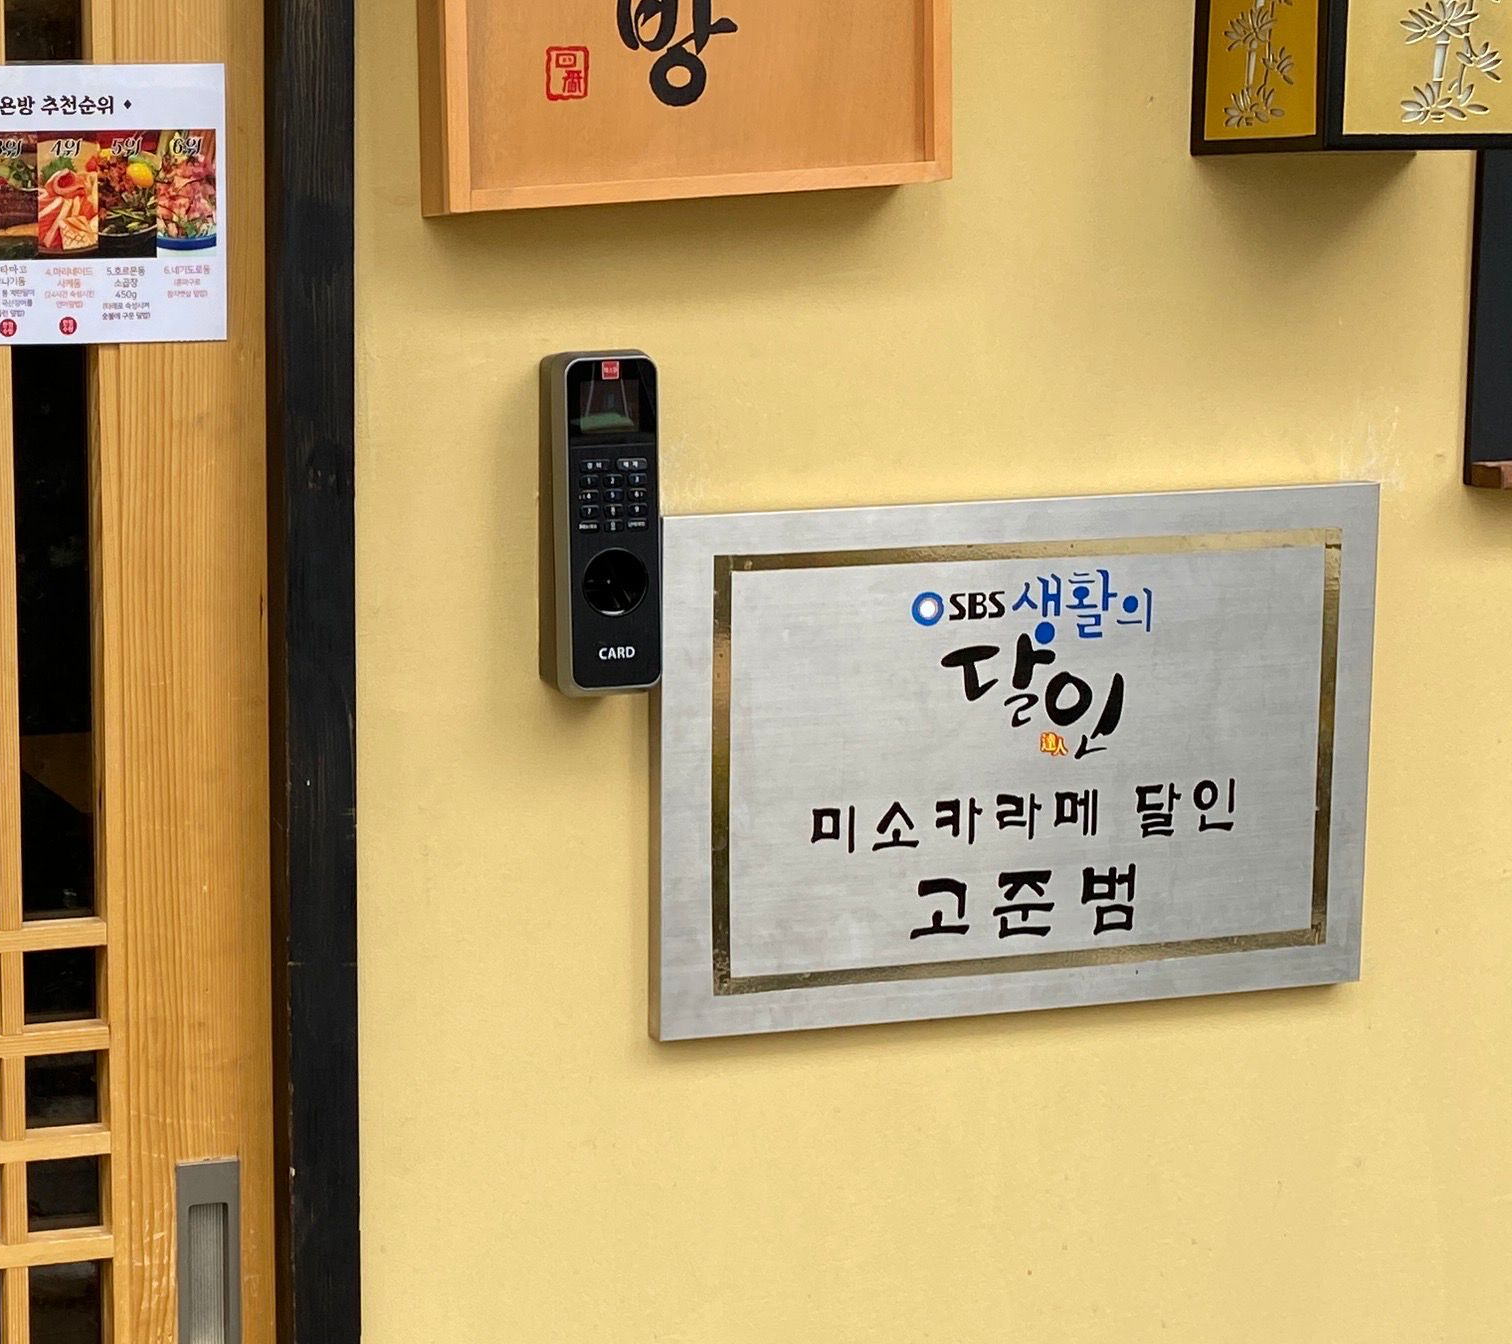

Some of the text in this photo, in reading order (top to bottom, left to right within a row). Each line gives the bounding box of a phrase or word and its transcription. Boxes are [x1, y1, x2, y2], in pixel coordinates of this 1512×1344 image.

[40, 96, 115, 116] 추천순위
[115, 290, 137, 300] 450g
[949, 569, 1152, 644] SBS 생활의
[598, 645, 636, 660] CARD
[941, 633, 1124, 760] 달인
[810, 777, 1238, 855] 미소카라메 달인
[909, 863, 1140, 942] 고준범
